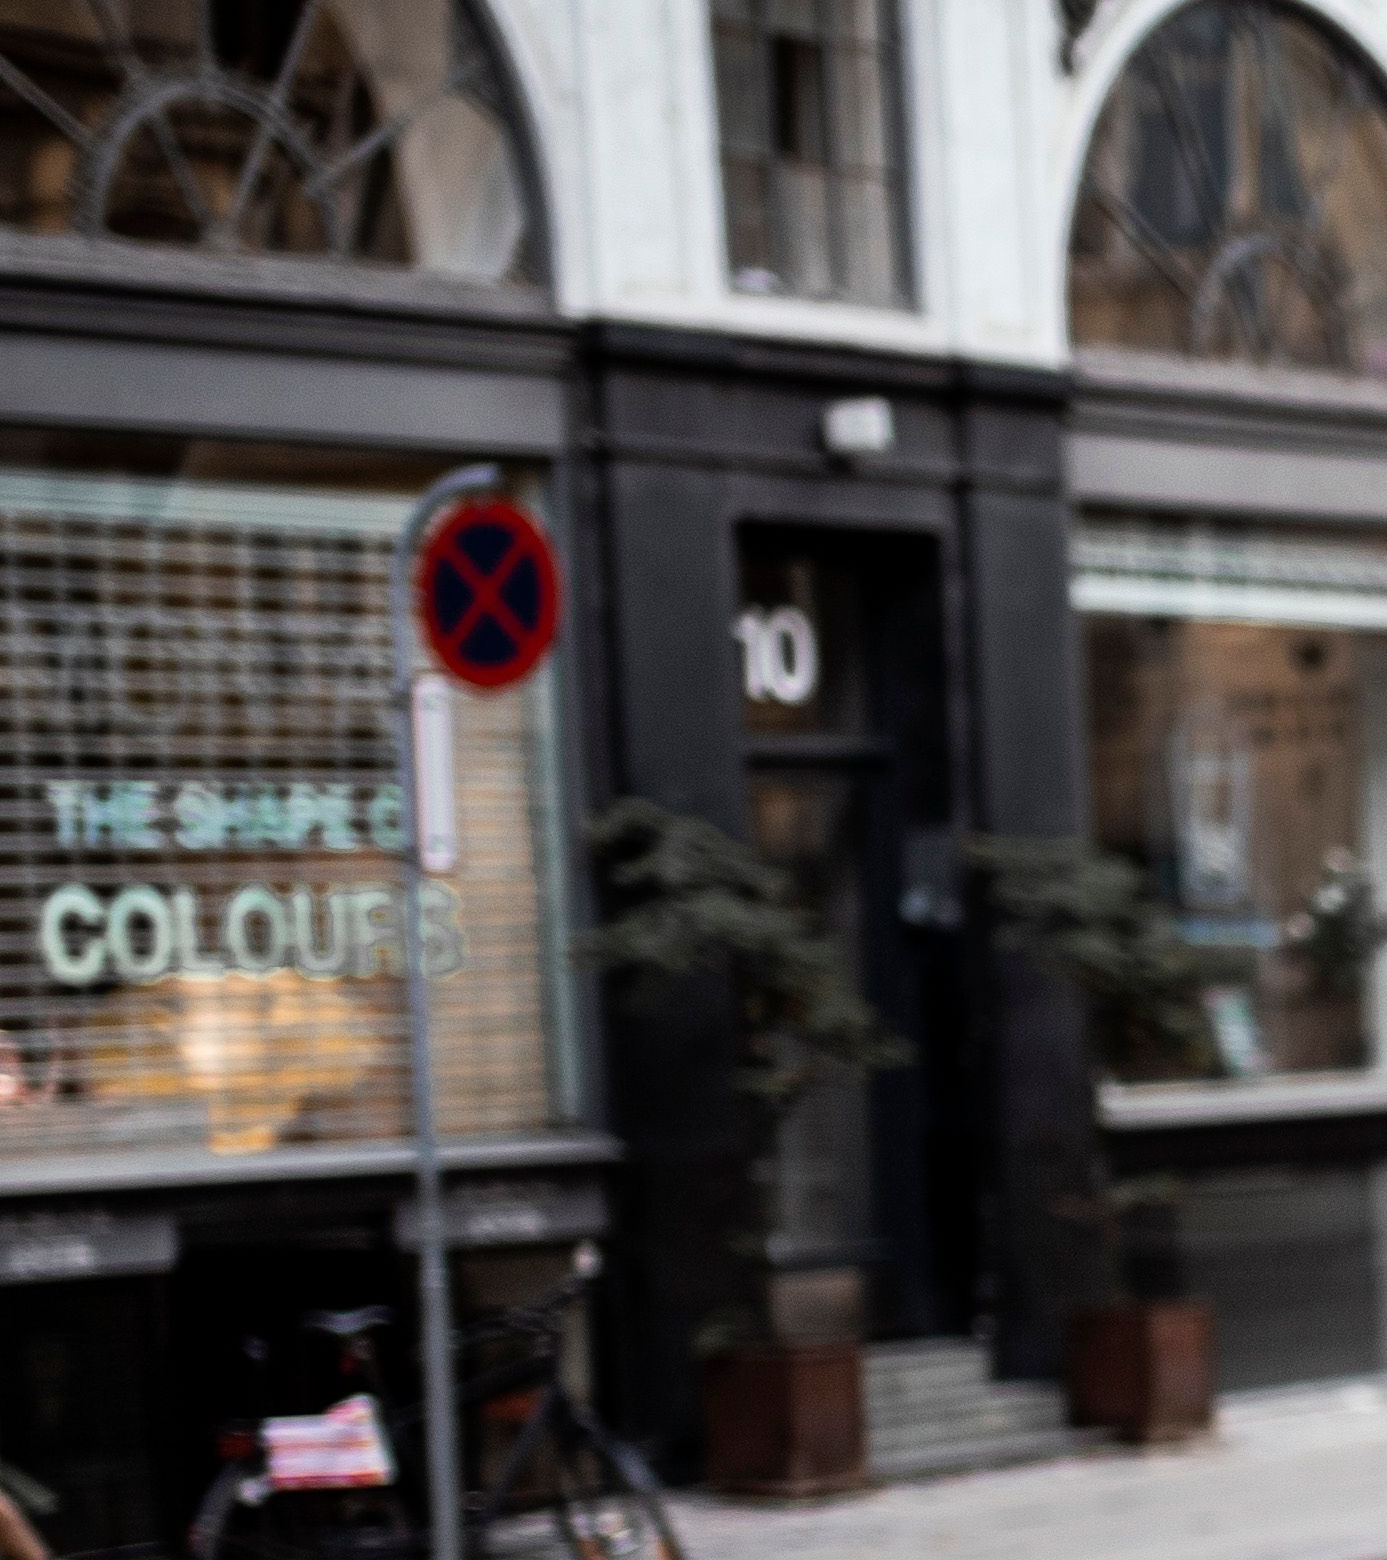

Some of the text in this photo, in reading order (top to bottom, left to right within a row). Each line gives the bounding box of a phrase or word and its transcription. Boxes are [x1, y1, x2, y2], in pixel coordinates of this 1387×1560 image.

[733, 608, 817, 702] 10
[48, 780, 163, 849] THE
[43, 884, 467, 984] COLOURS
